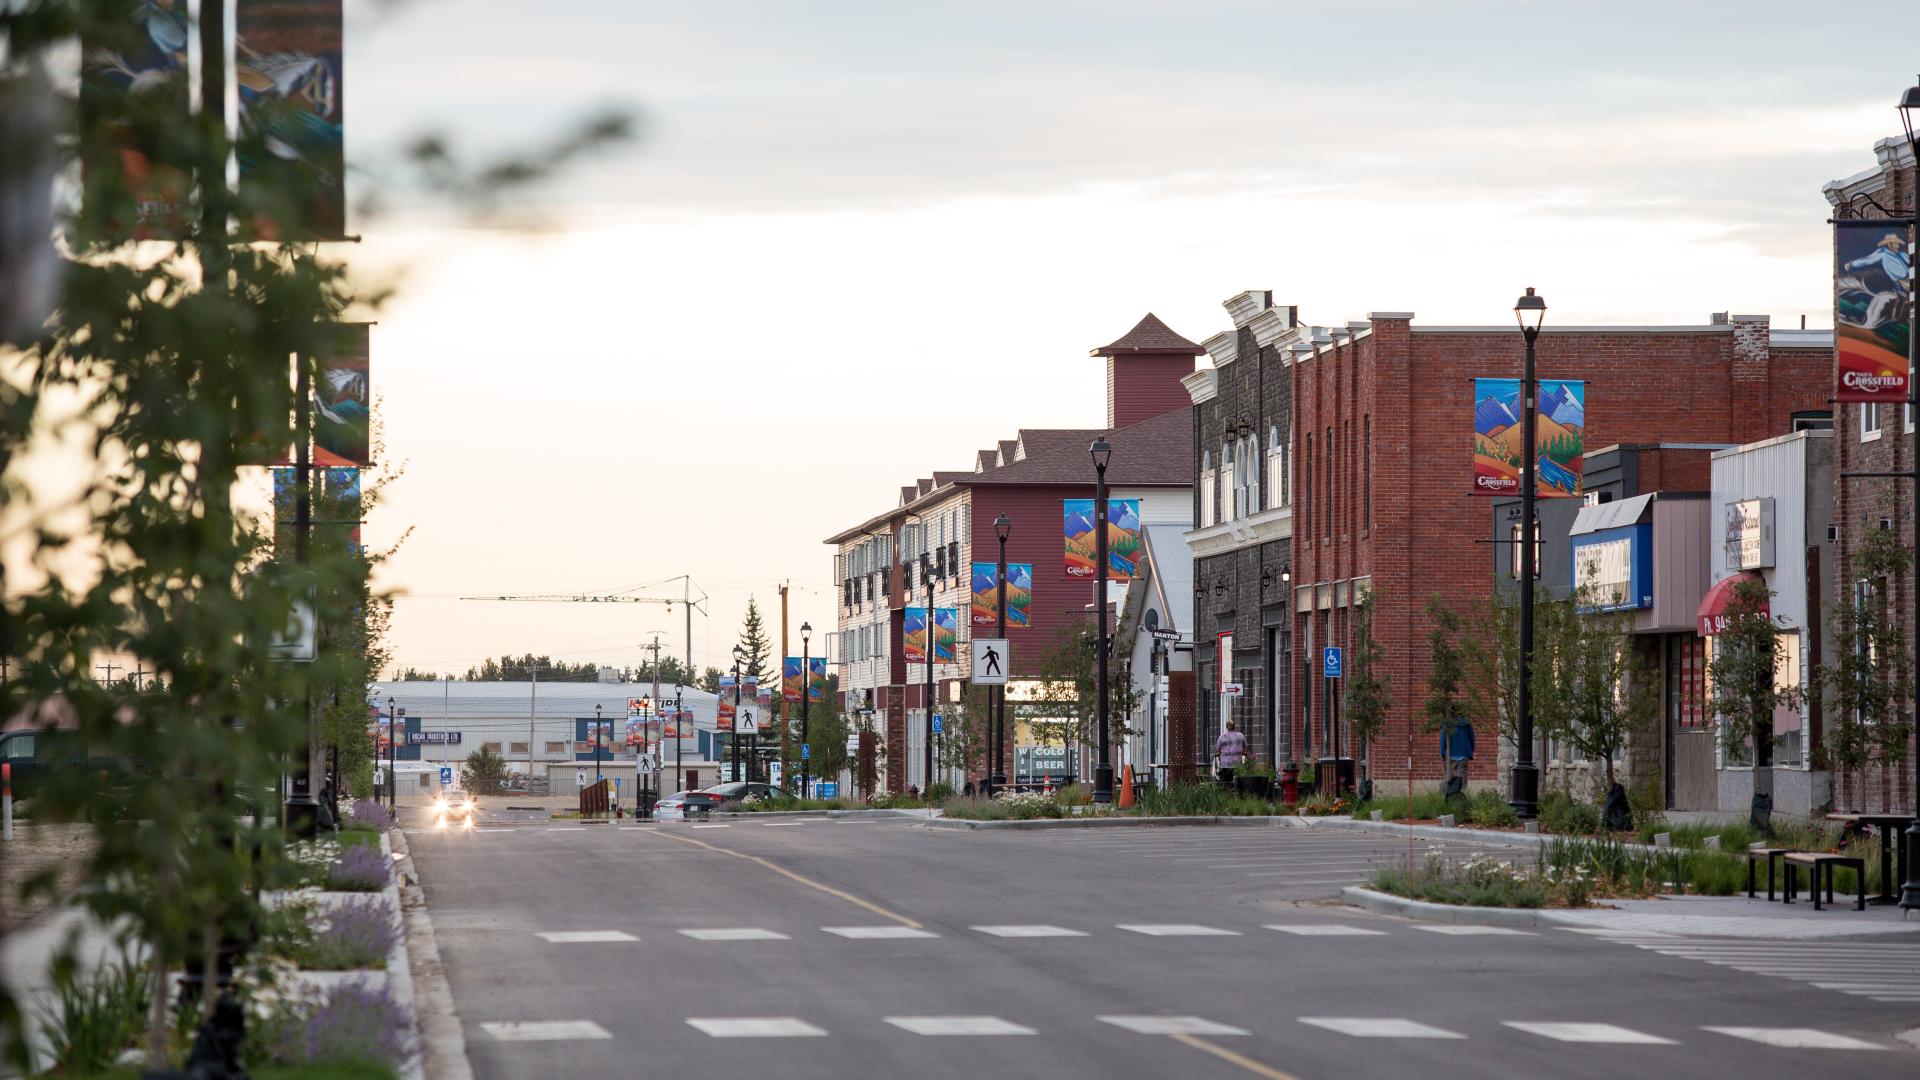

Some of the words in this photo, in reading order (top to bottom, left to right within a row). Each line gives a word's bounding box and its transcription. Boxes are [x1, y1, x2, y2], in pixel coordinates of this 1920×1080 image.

[1843, 371, 1904, 392] CROSSFIELD
[1478, 476, 1516, 489] CROSSFIELD
[1154, 632, 1180, 640] NANTON
[1036, 761, 1065, 769] BEER
